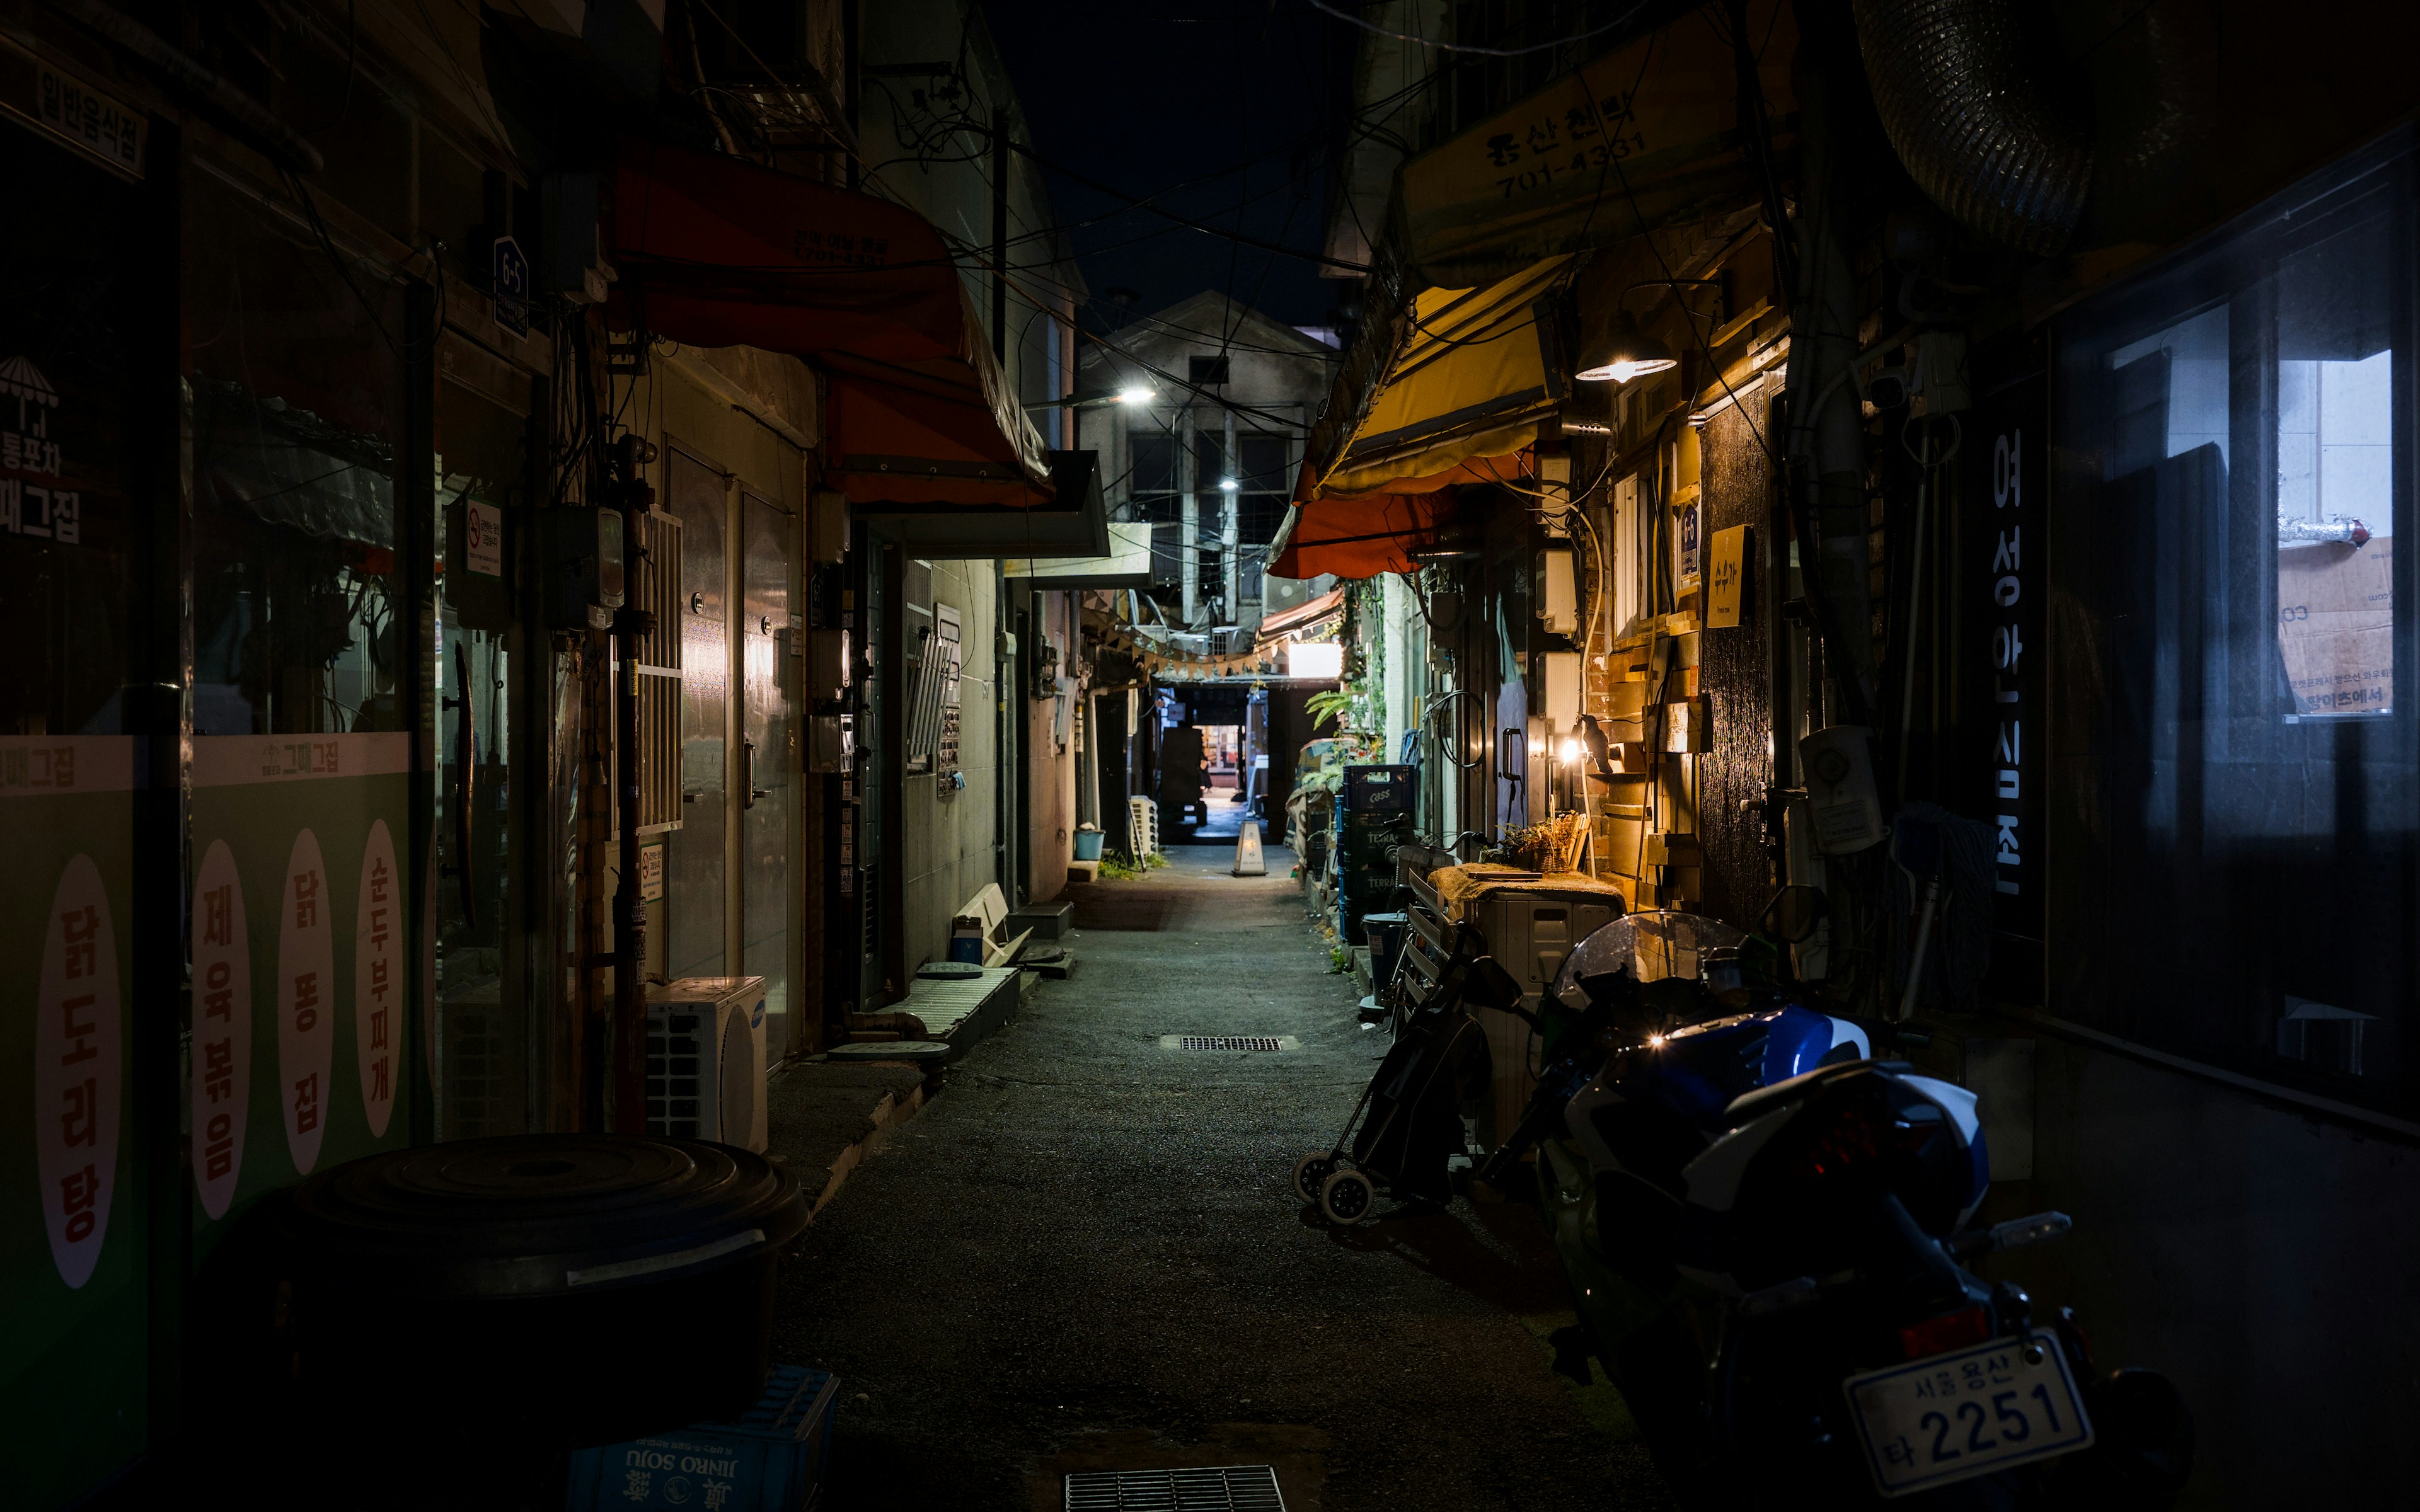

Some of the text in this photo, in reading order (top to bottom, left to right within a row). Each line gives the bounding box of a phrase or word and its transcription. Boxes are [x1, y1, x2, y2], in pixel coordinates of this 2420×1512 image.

[42, 71, 137, 164] 일반음식점
[1486, 89, 1635, 168] 용산천막
[1496, 132, 1645, 198] 701-4331
[502, 252, 521, 294] 6-5
[1683, 513, 1695, 543] 6-6
[1714, 559, 1737, 596] 수우가
[0, 746, 74, 788] 때그집
[1367, 876, 1395, 888] TERRA
[293, 869, 319, 1135] 닭똥집
[371, 857, 389, 1102] 순두부찌개
[204, 884, 233, 1181] 제육볶음
[60, 905, 100, 1243] 닭도리탕
[1916, 1354, 2014, 1399] 서울 용산
[1882, 1383, 2061, 1467] 타 2251
[625, 1450, 740, 1479] JINRO SOJU
